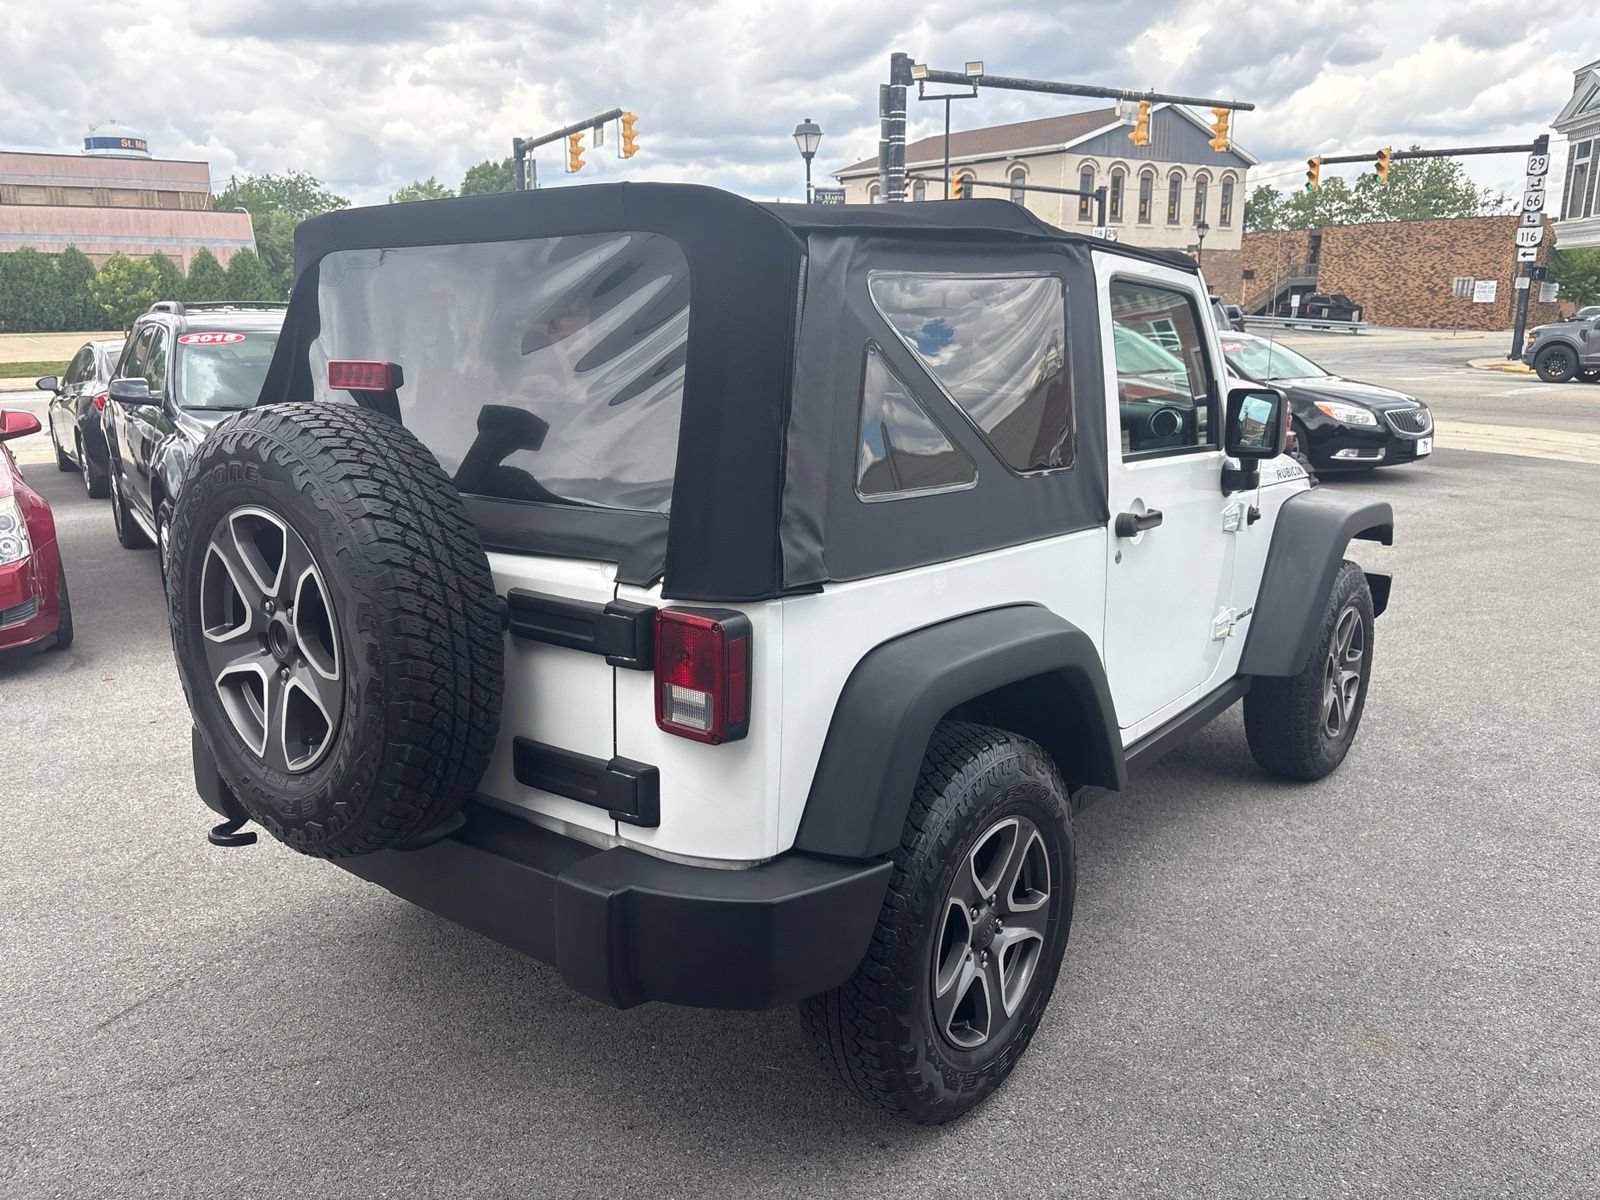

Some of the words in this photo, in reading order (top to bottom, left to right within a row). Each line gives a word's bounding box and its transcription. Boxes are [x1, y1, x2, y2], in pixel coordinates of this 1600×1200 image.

[1530, 157, 1545, 171] 29
[1526, 195, 1541, 207] 66
[1107, 228, 1117, 239] 29
[1521, 232, 1537, 243] 116
